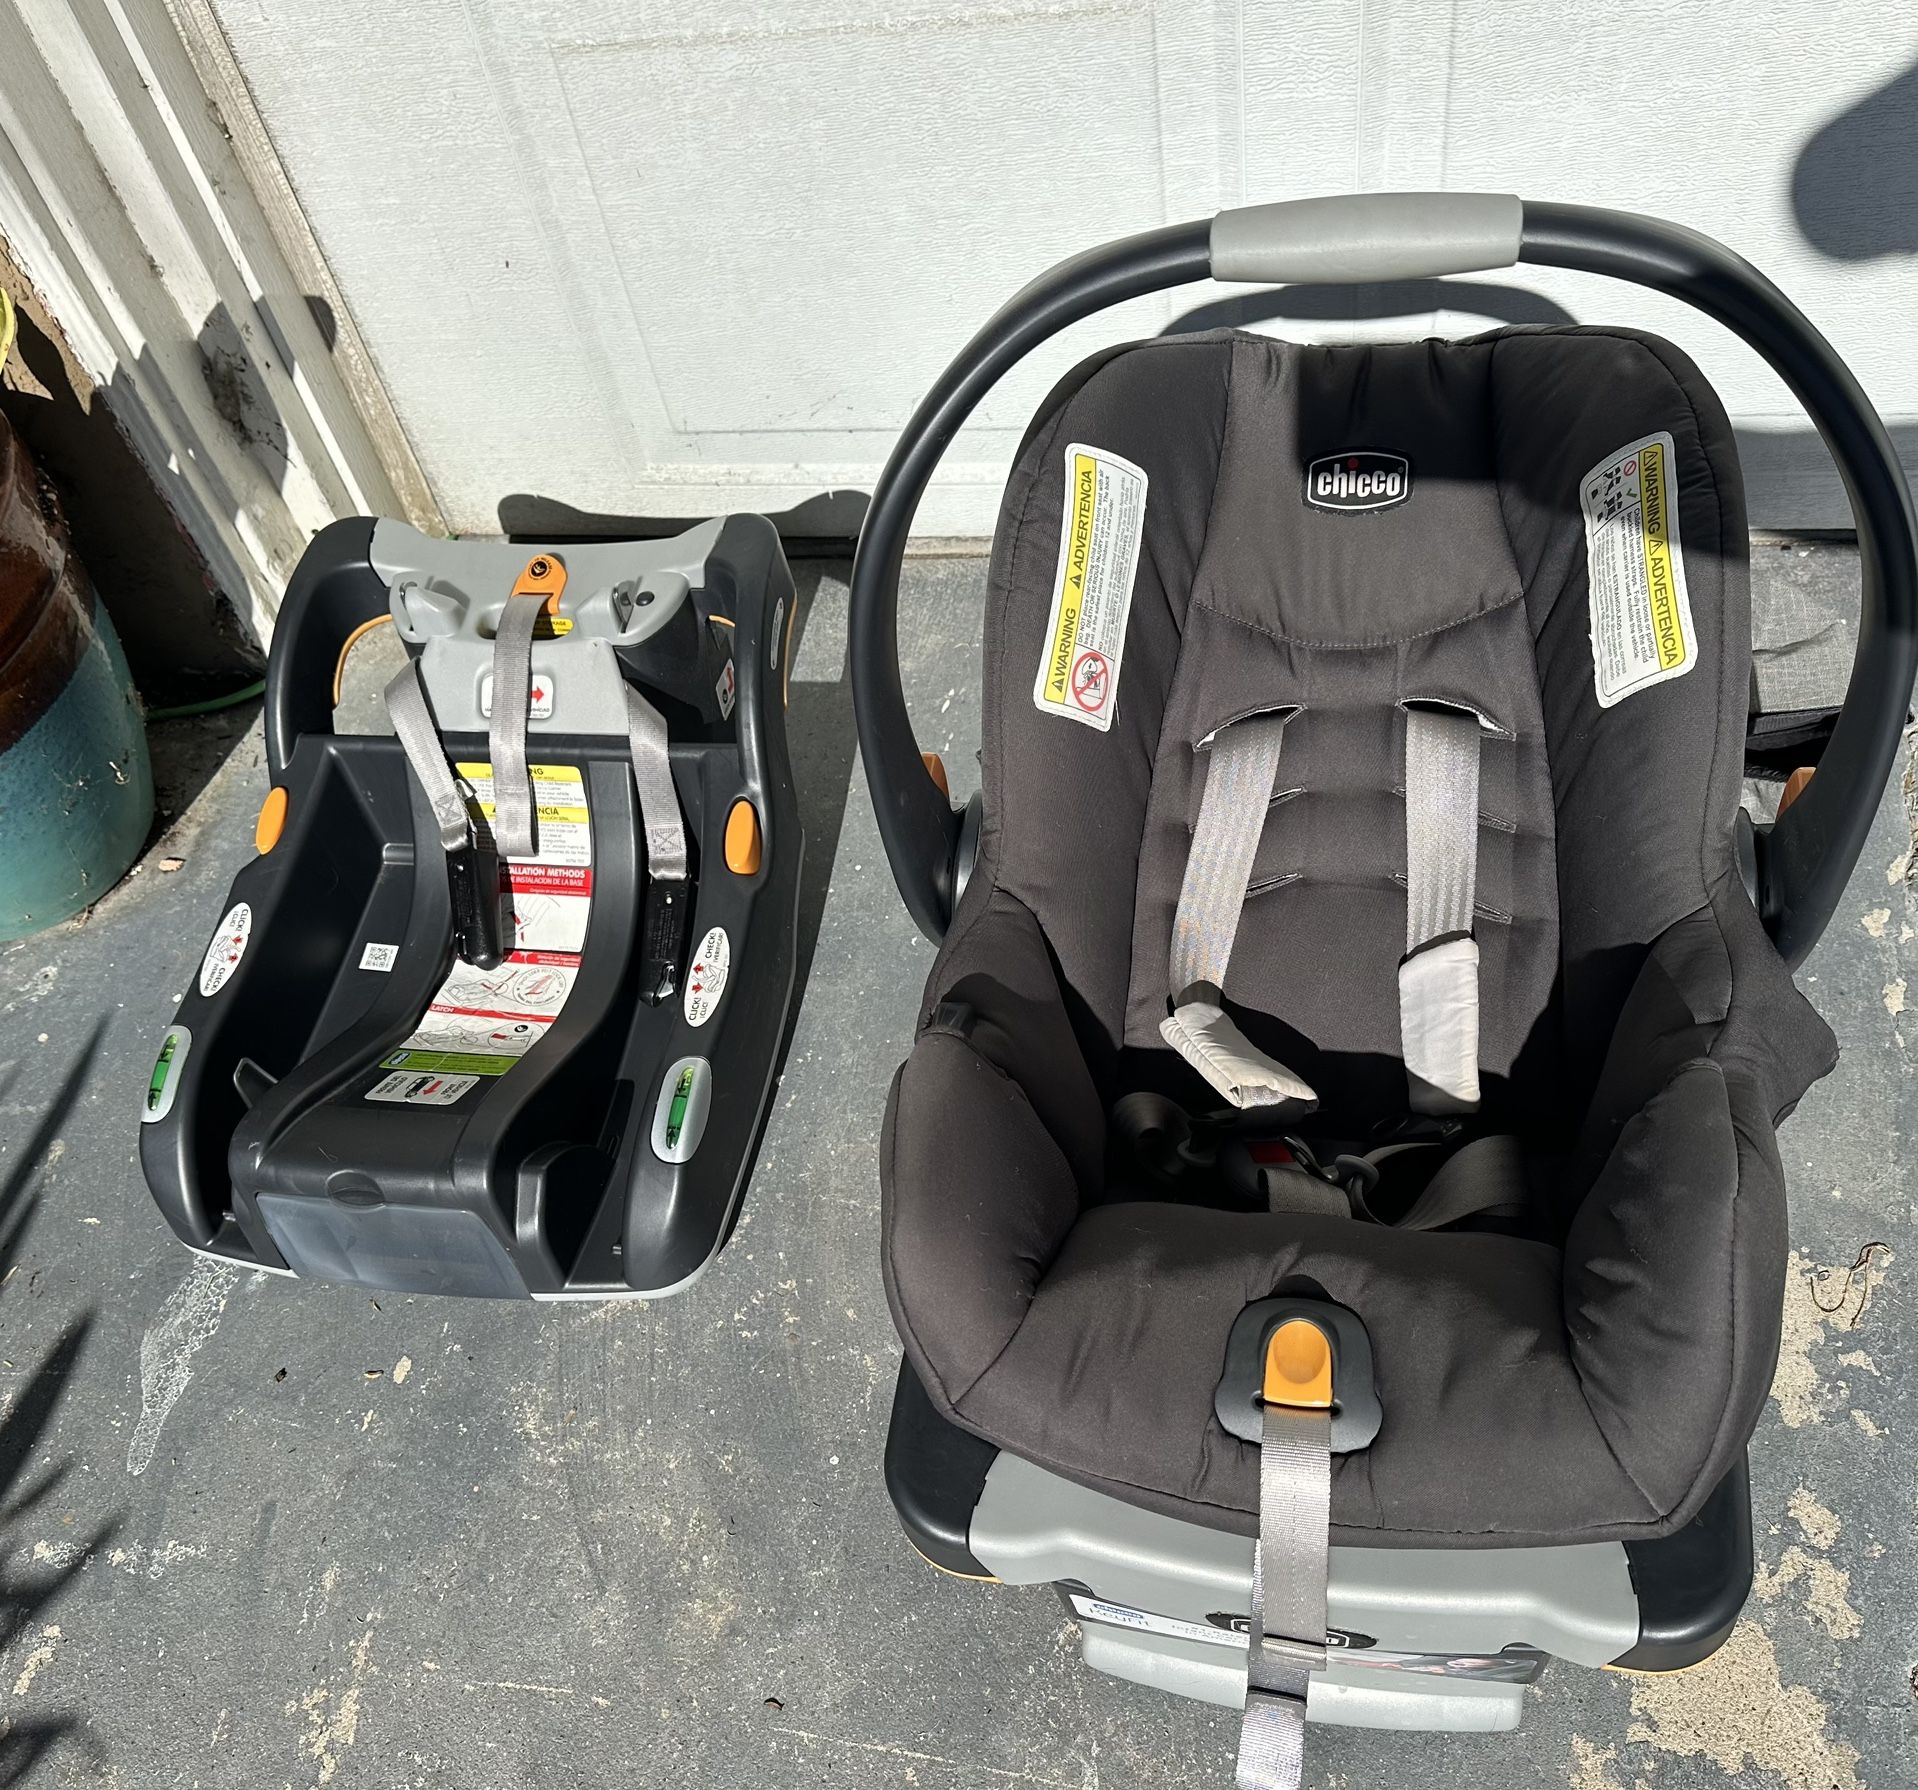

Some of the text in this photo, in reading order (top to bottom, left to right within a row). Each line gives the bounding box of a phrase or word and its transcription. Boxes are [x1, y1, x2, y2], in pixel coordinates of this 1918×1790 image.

[1317, 457, 1400, 498] chicco
[1634, 508, 1642, 536] Children
[1055, 470, 1092, 676] WARNING ADVERTENCIA
[1638, 553, 1646, 595] STRANGLED
[1644, 464, 1677, 665] WARNING ADVERTENCIA
[1632, 590, 1640, 608] Fully
[1646, 623, 1650, 631] or
[1646, 631, 1655, 660] partially
[547, 867, 585, 878] METHODS
[236, 909, 248, 931] CLICK!
[705, 932, 716, 958] CHECK!
[211, 967, 225, 991] CHECK!
[431, 1004, 454, 1012] LATCH
[689, 997, 701, 1020] CLICK!
